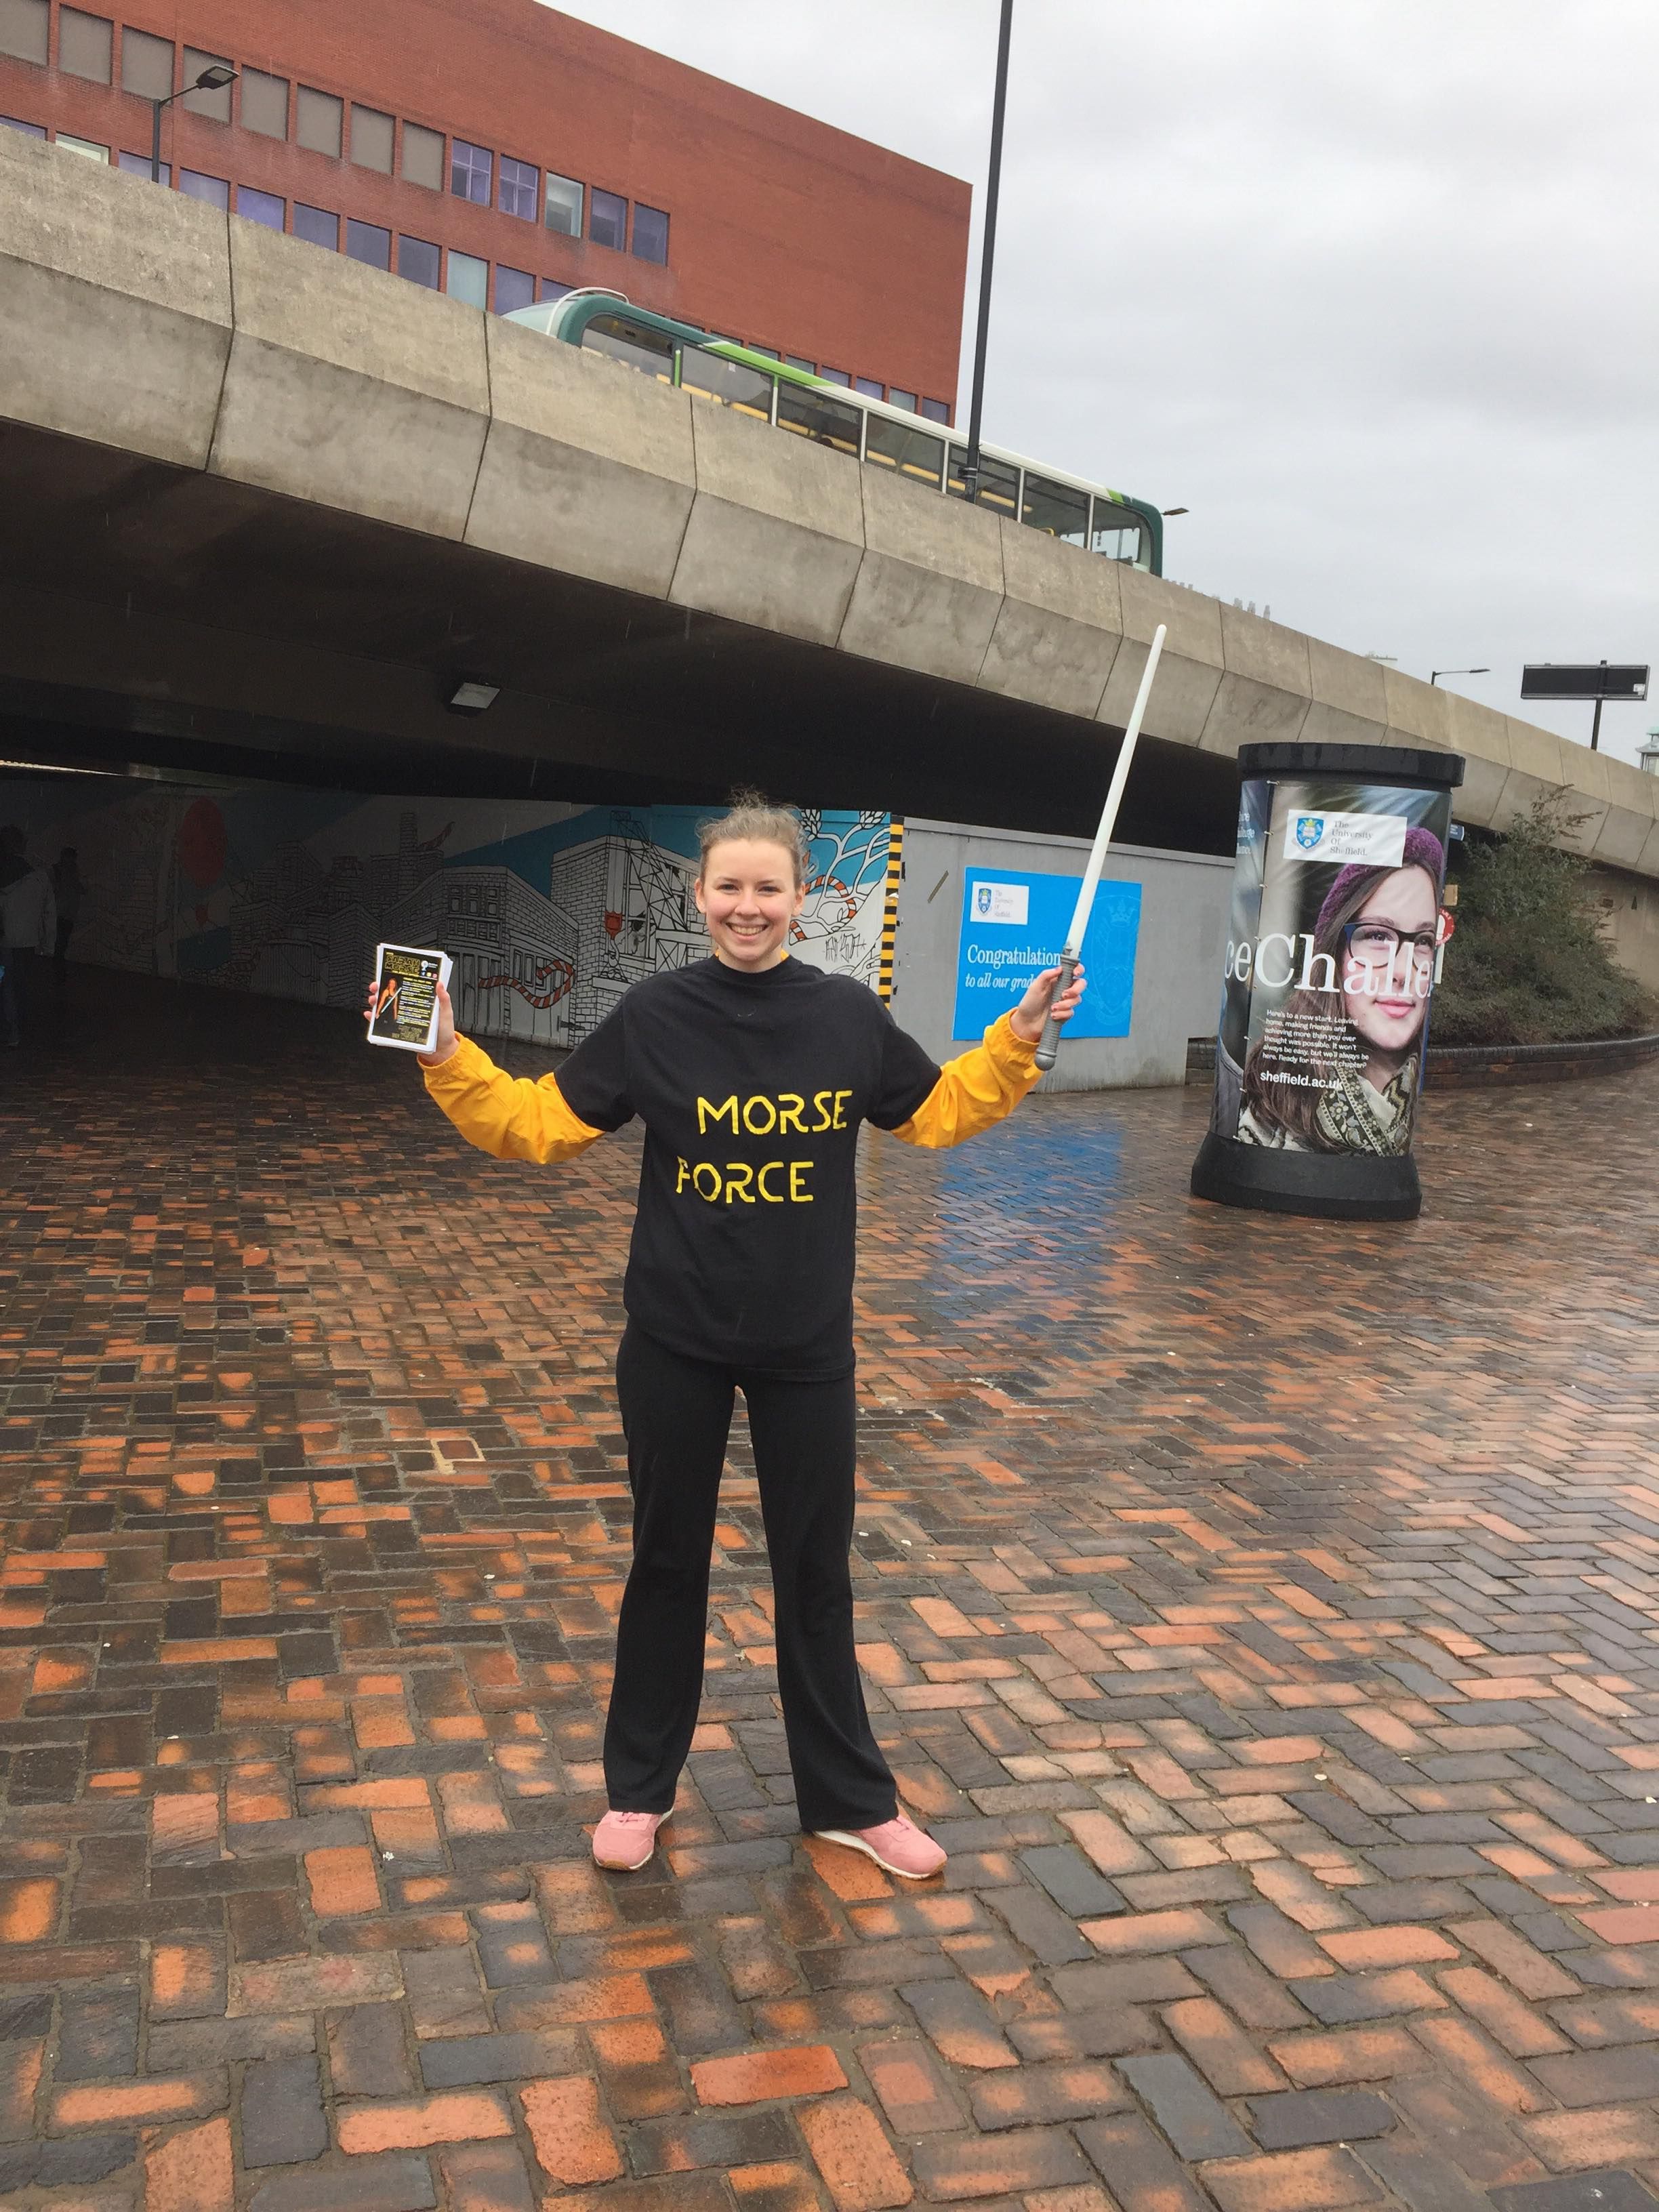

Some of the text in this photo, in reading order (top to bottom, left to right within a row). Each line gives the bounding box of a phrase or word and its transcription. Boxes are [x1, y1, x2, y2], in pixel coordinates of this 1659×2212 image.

[1334, 820, 1349, 828] The
[967, 944, 1061, 970] Congratulation
[965, 972, 975, 987] to
[977, 972, 991, 987] all
[992, 977, 1010, 988] our
[1285, 1021, 1309, 1030] making
[1309, 1023, 1332, 1031] friends
[1334, 1017, 1358, 1026] Leaving
[1264, 1027, 1292, 1038] achieving
[1264, 1035, 1288, 1044] thought
[1263, 1043, 1283, 1053] always
[1338, 1052, 1360, 1061] always
[1278, 1054, 1298, 1063] Ready
[1338, 1061, 1367, 1069] chapter?
[1260, 1071, 1343, 1090] sheffield.ac.uk
[697, 1090, 853, 1134] MORSE
[676, 1155, 814, 1204] FORCE
